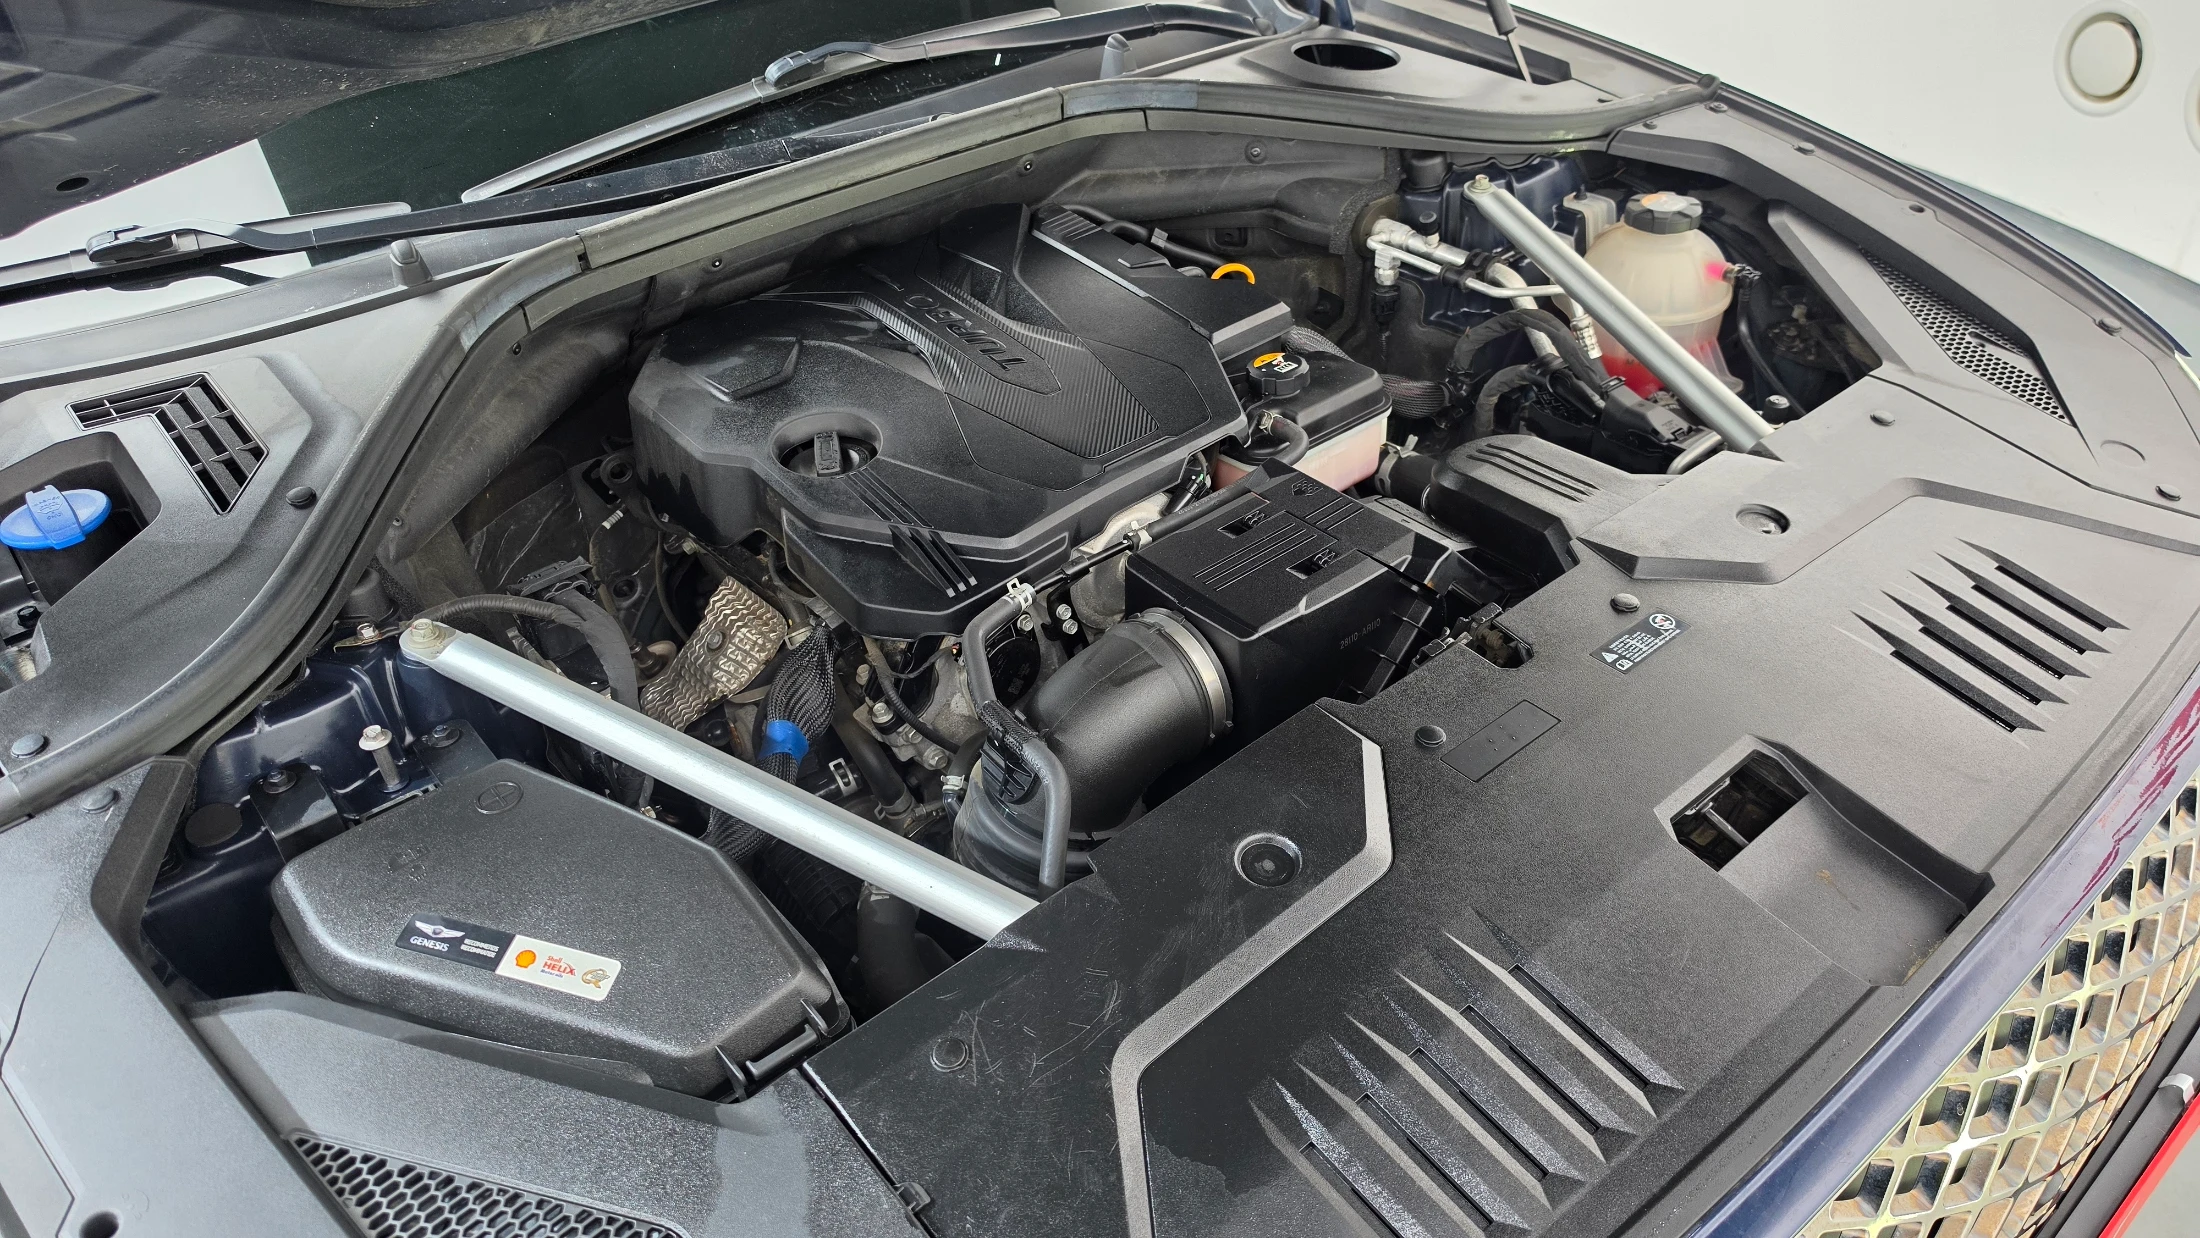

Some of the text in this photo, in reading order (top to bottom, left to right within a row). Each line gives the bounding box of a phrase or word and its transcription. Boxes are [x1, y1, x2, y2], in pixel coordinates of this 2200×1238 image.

[904, 294, 1027, 372] TURBO
[410, 936, 450, 952] GENESIS
[543, 961, 576, 976] HELIX
